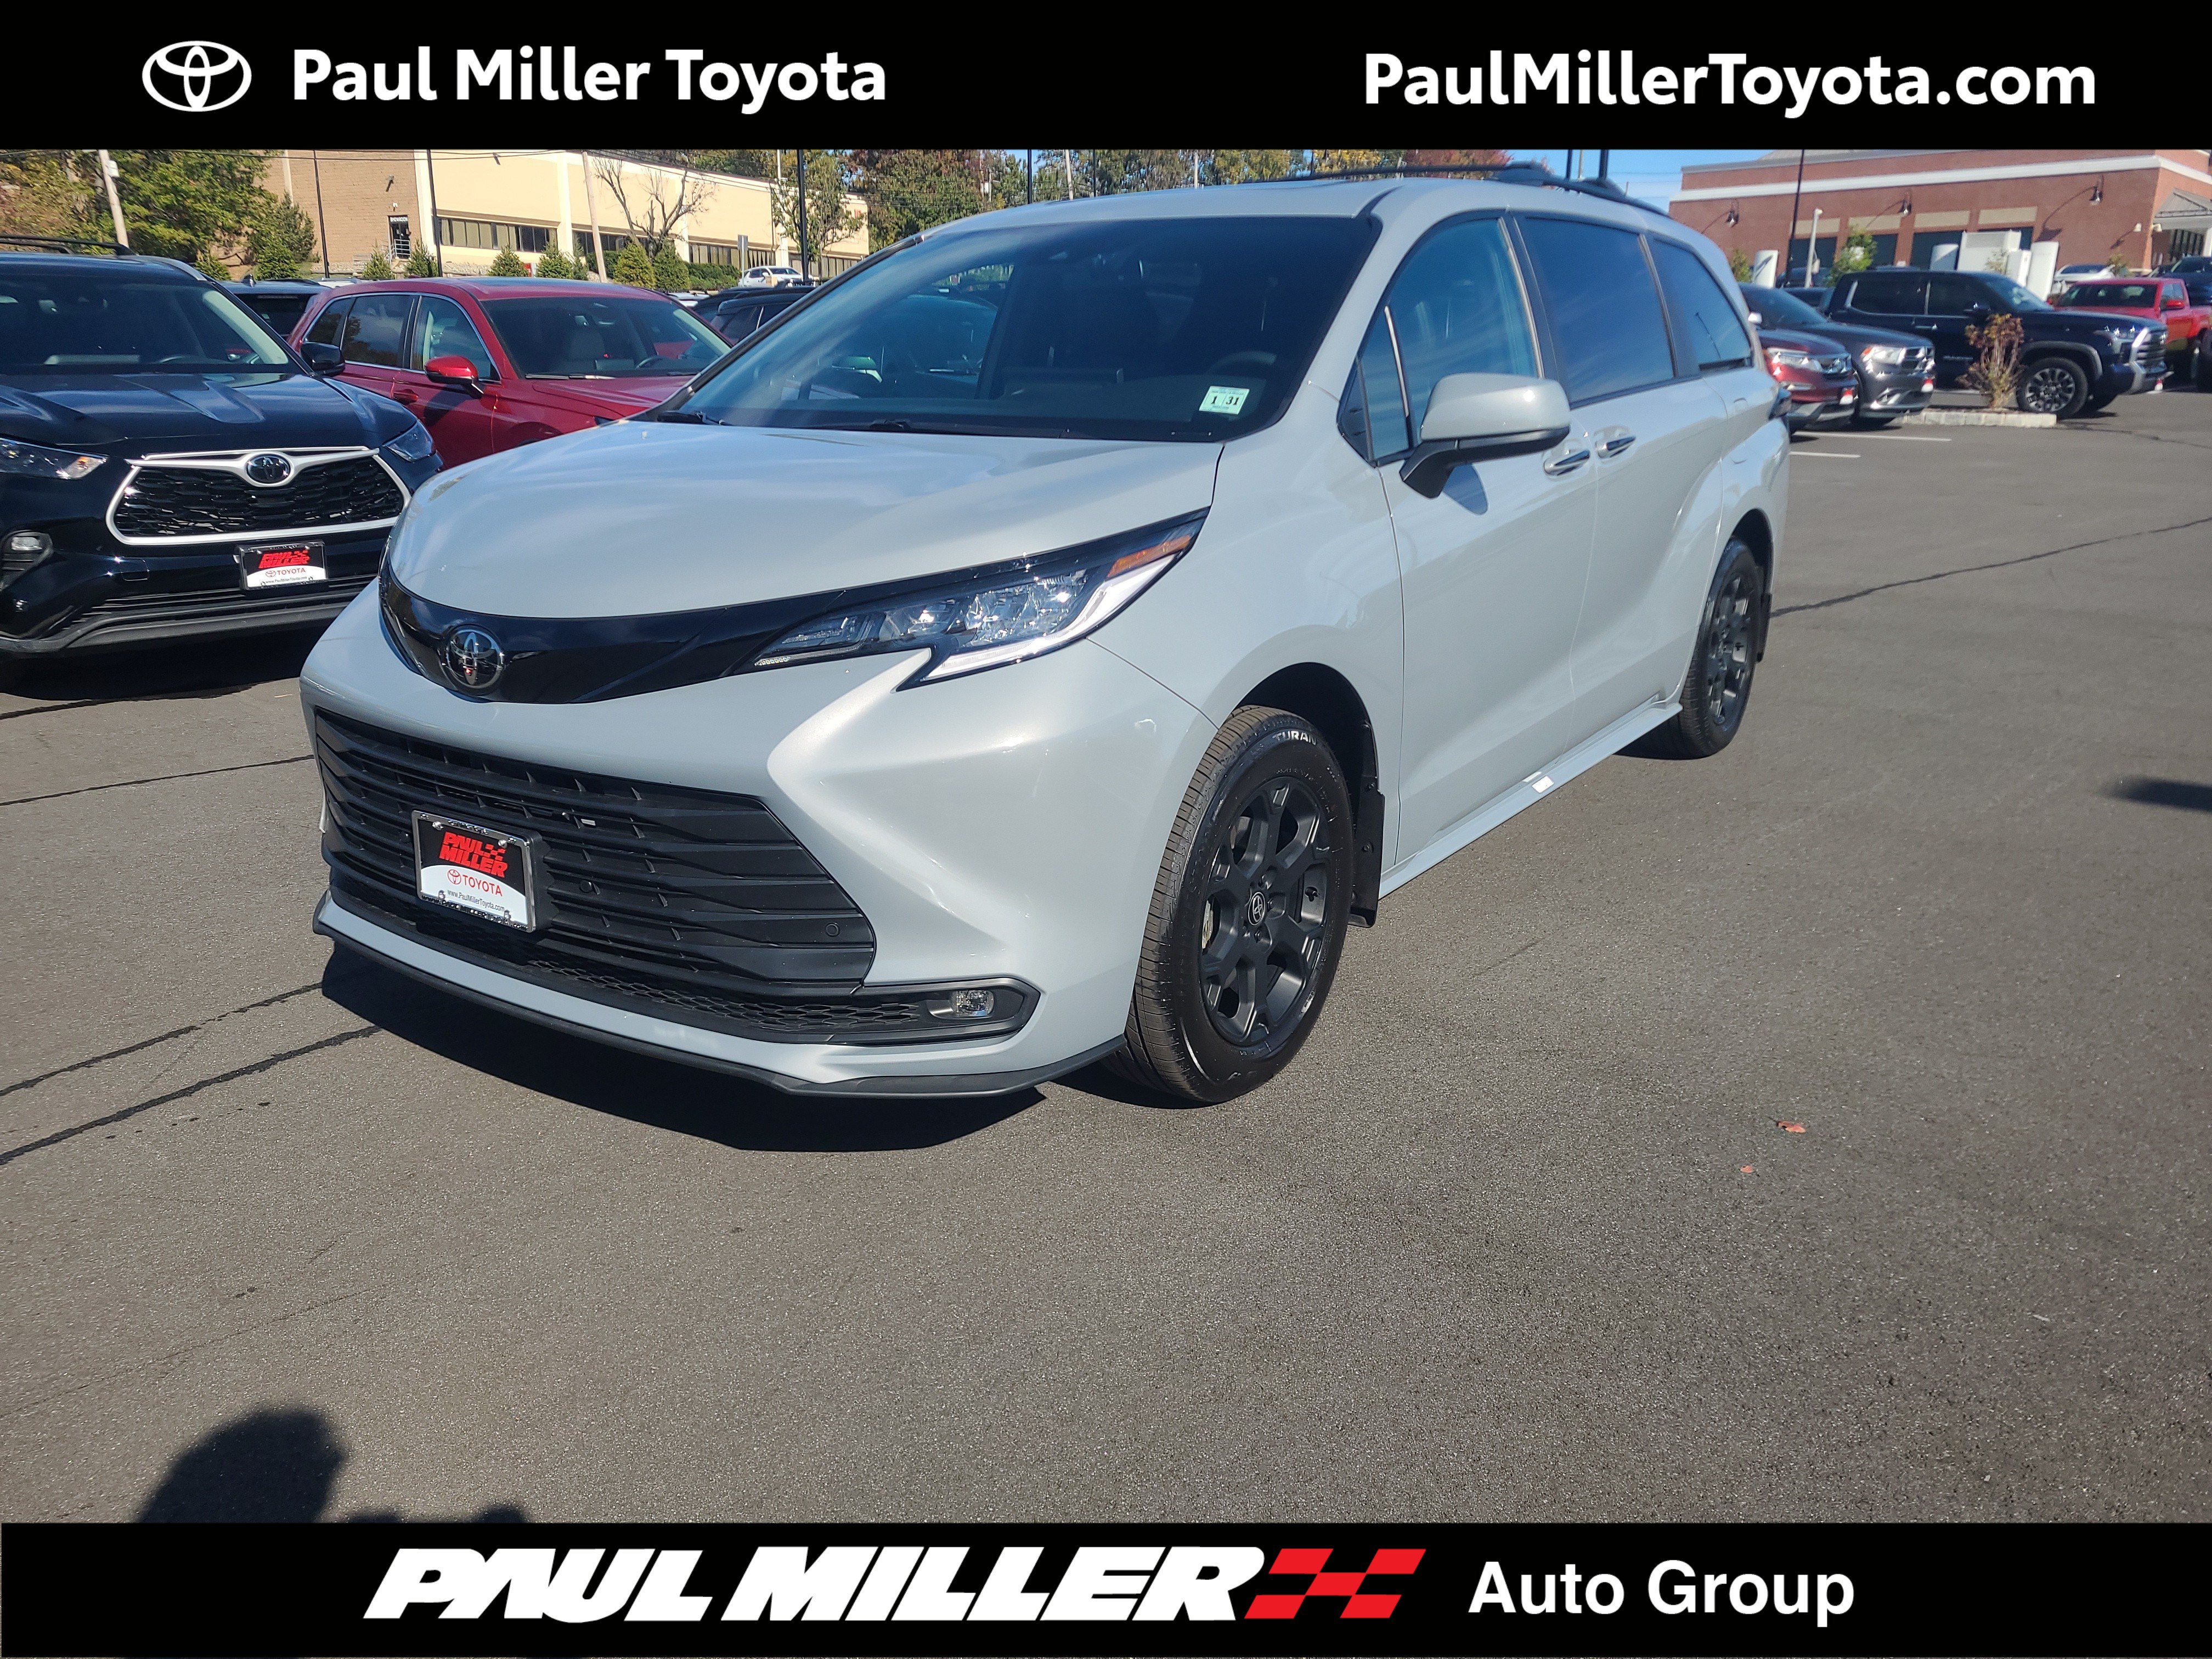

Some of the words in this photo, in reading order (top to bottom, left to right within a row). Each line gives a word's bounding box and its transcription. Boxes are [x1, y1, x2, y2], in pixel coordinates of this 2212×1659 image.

[1210, 396, 1217, 404] 1
[1226, 396, 1239, 405] 31
[442, 831, 486, 856] PAUL
[439, 845, 508, 878] MILLER
[462, 874, 503, 897] TOYOTA
[447, 889, 505, 912] www.PaulMillerToyota.com
